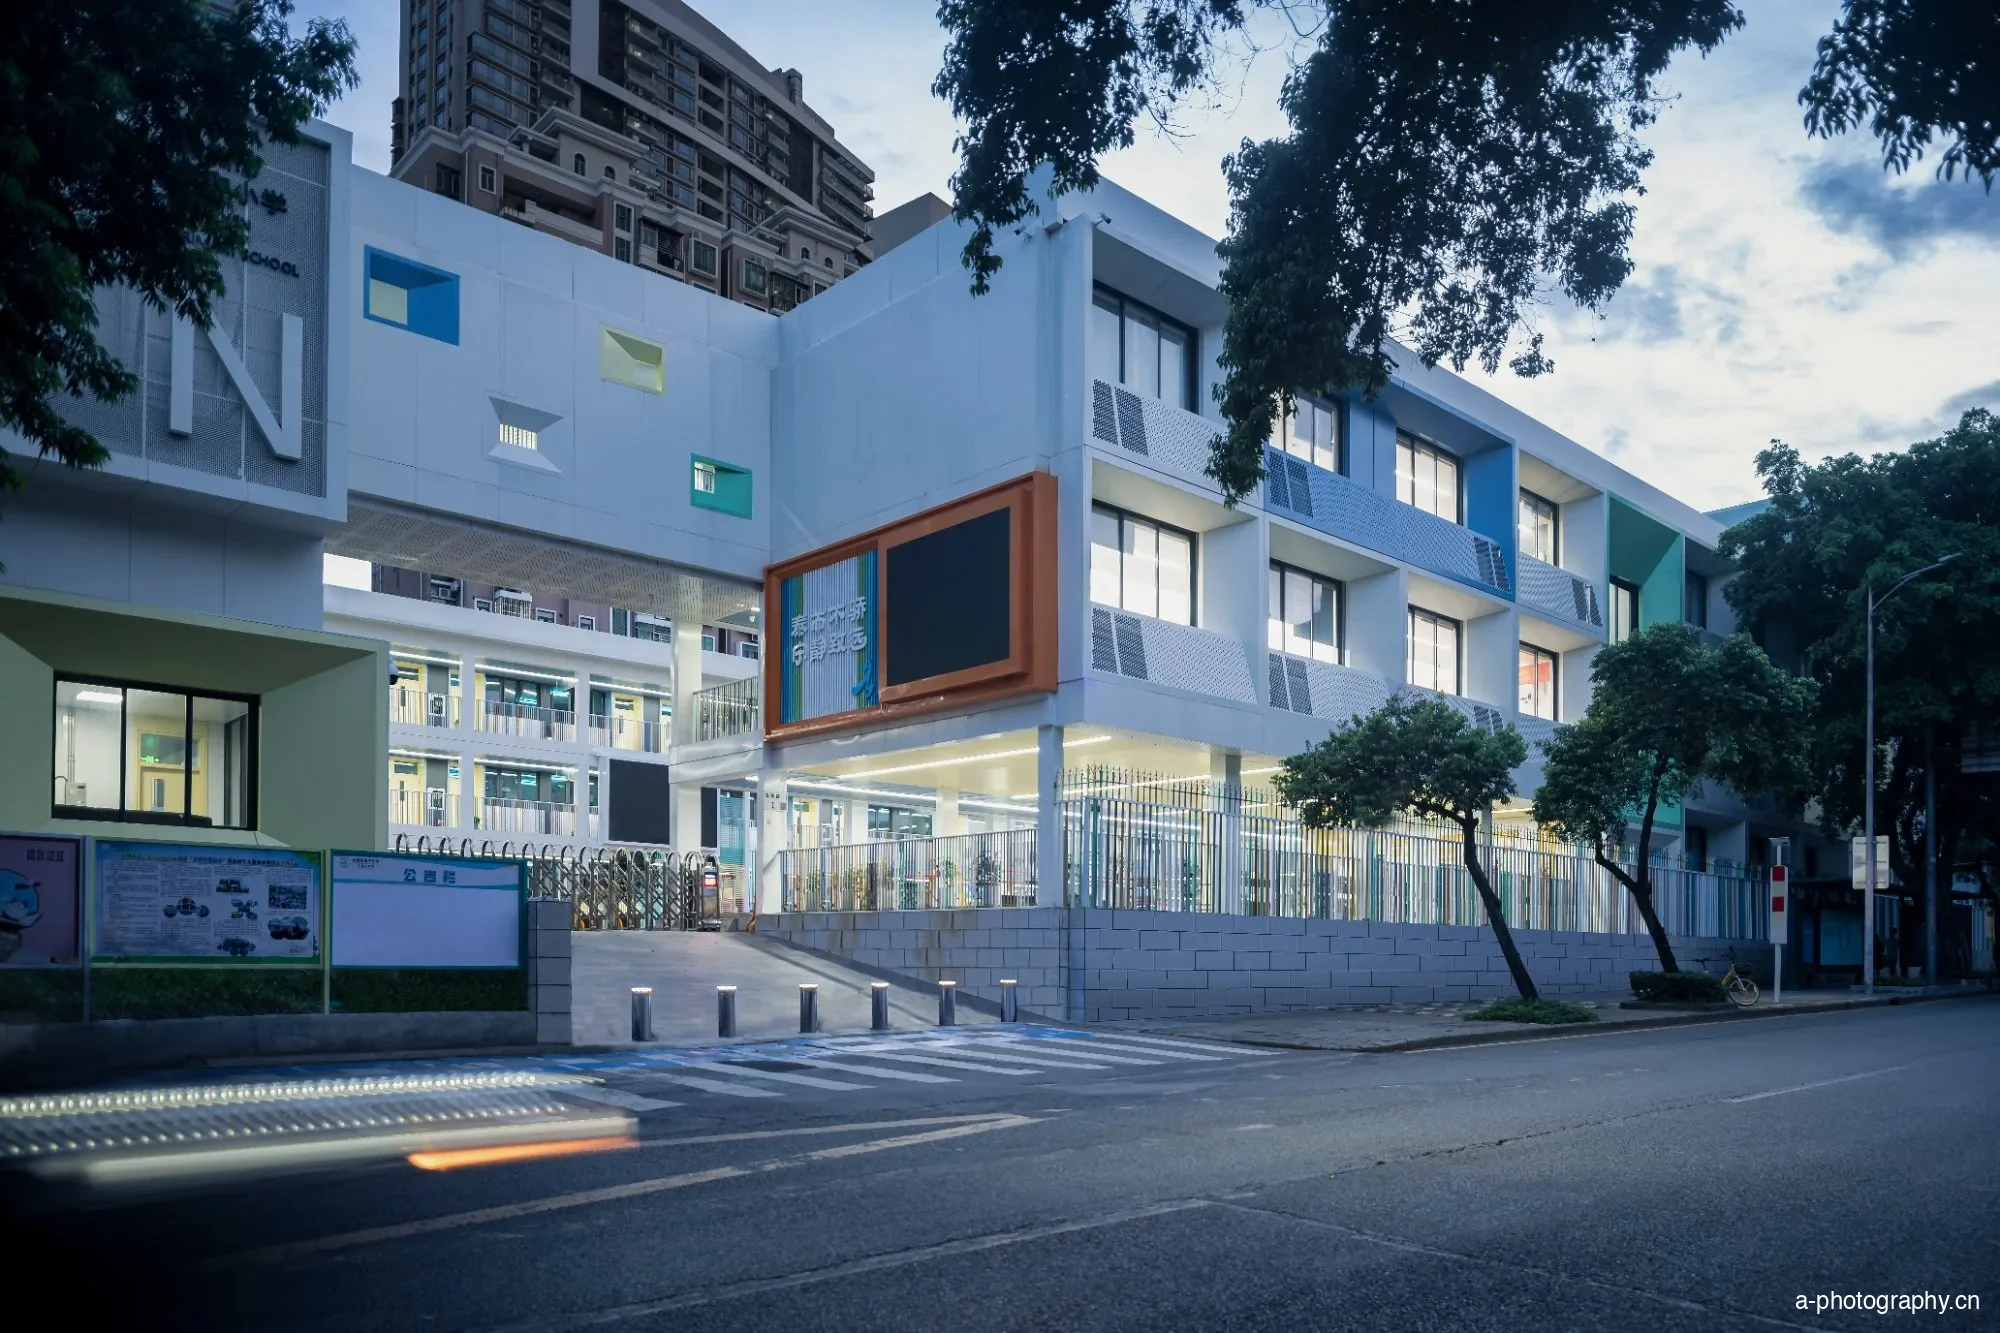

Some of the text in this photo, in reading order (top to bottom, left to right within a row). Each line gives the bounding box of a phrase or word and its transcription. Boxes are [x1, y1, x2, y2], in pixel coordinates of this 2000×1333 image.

[792, 626, 867, 666] 宁静致远
[403, 868, 456, 884] 公告栏
